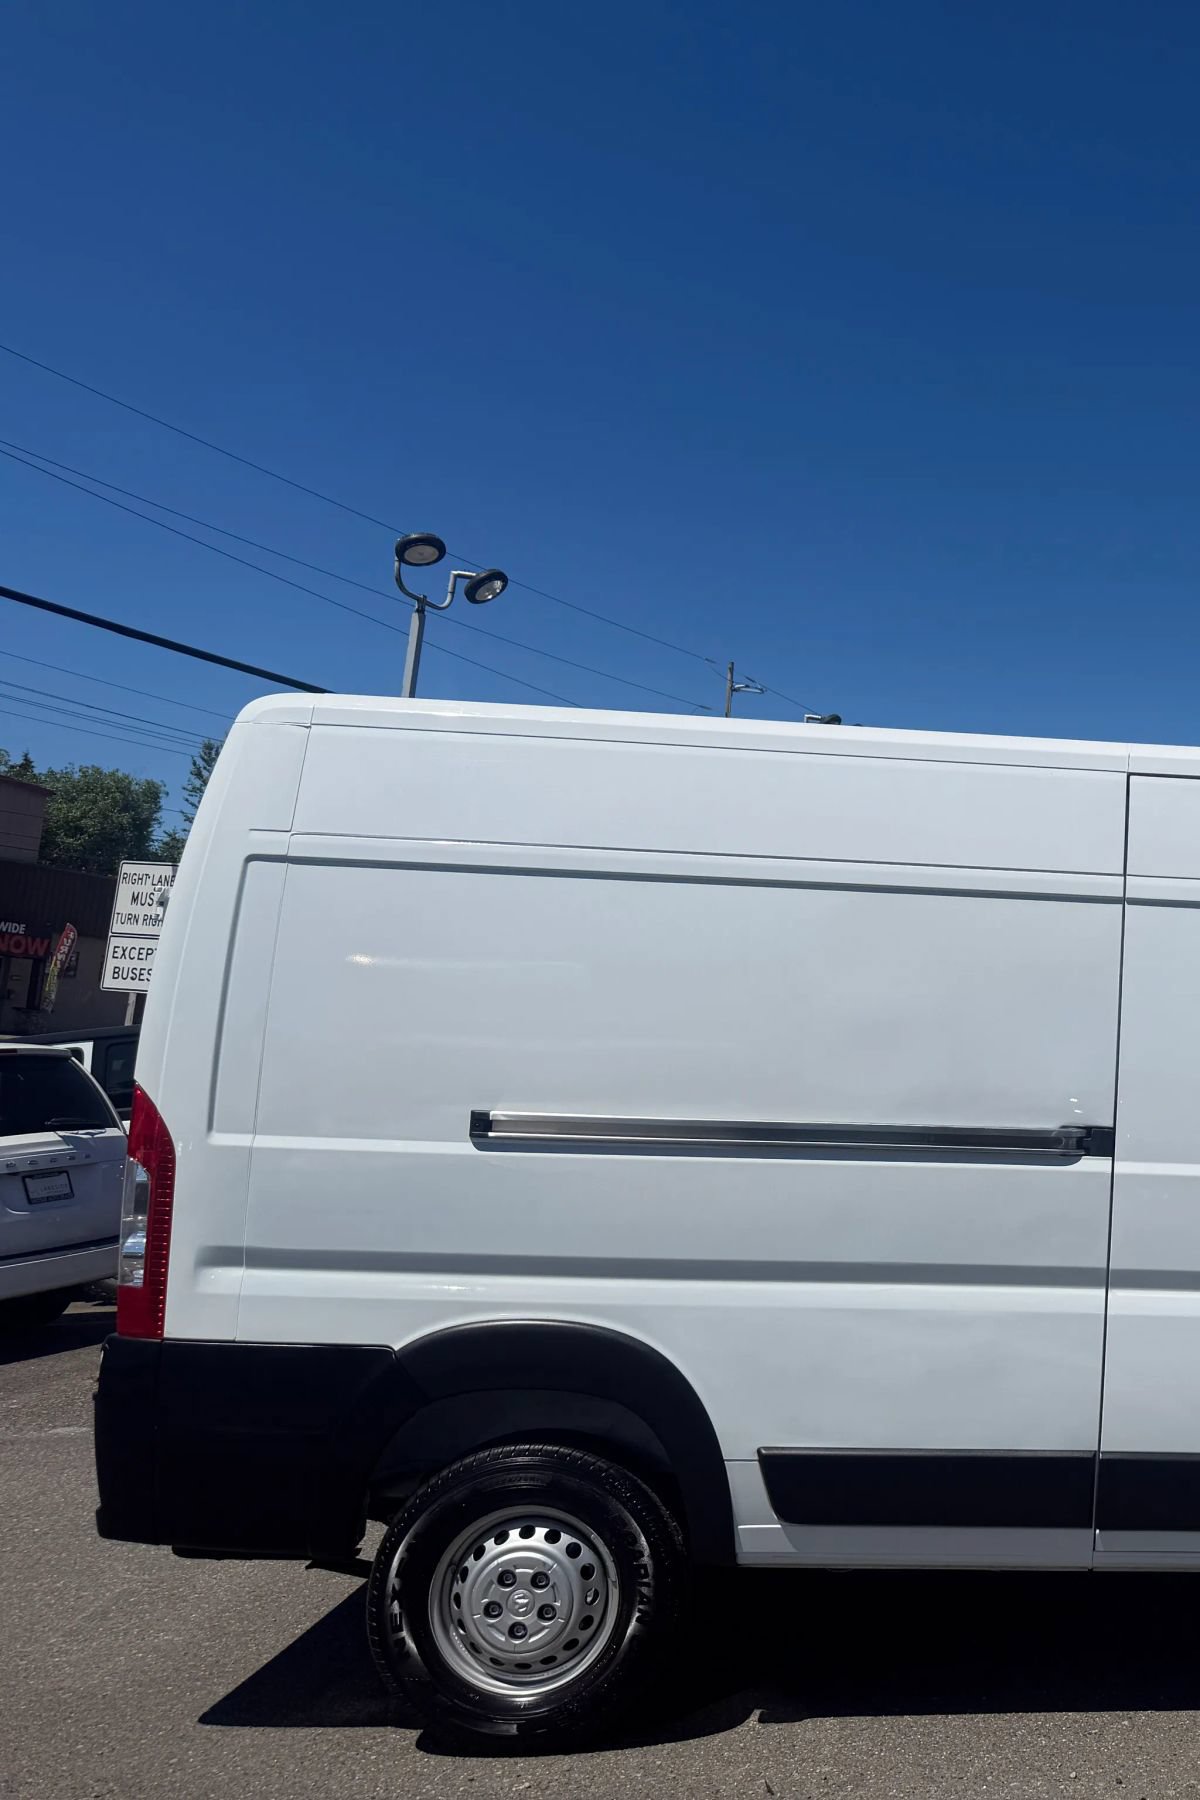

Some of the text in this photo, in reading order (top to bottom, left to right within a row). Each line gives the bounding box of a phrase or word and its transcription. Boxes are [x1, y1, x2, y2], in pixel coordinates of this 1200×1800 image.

[121, 872, 176, 887] RIGHT LANE
[130, 892, 155, 907] MUS
[115, 912, 163, 927] TURN RIGH
[112, 945, 157, 961] EXCEP
[112, 965, 152, 982] BUSES
